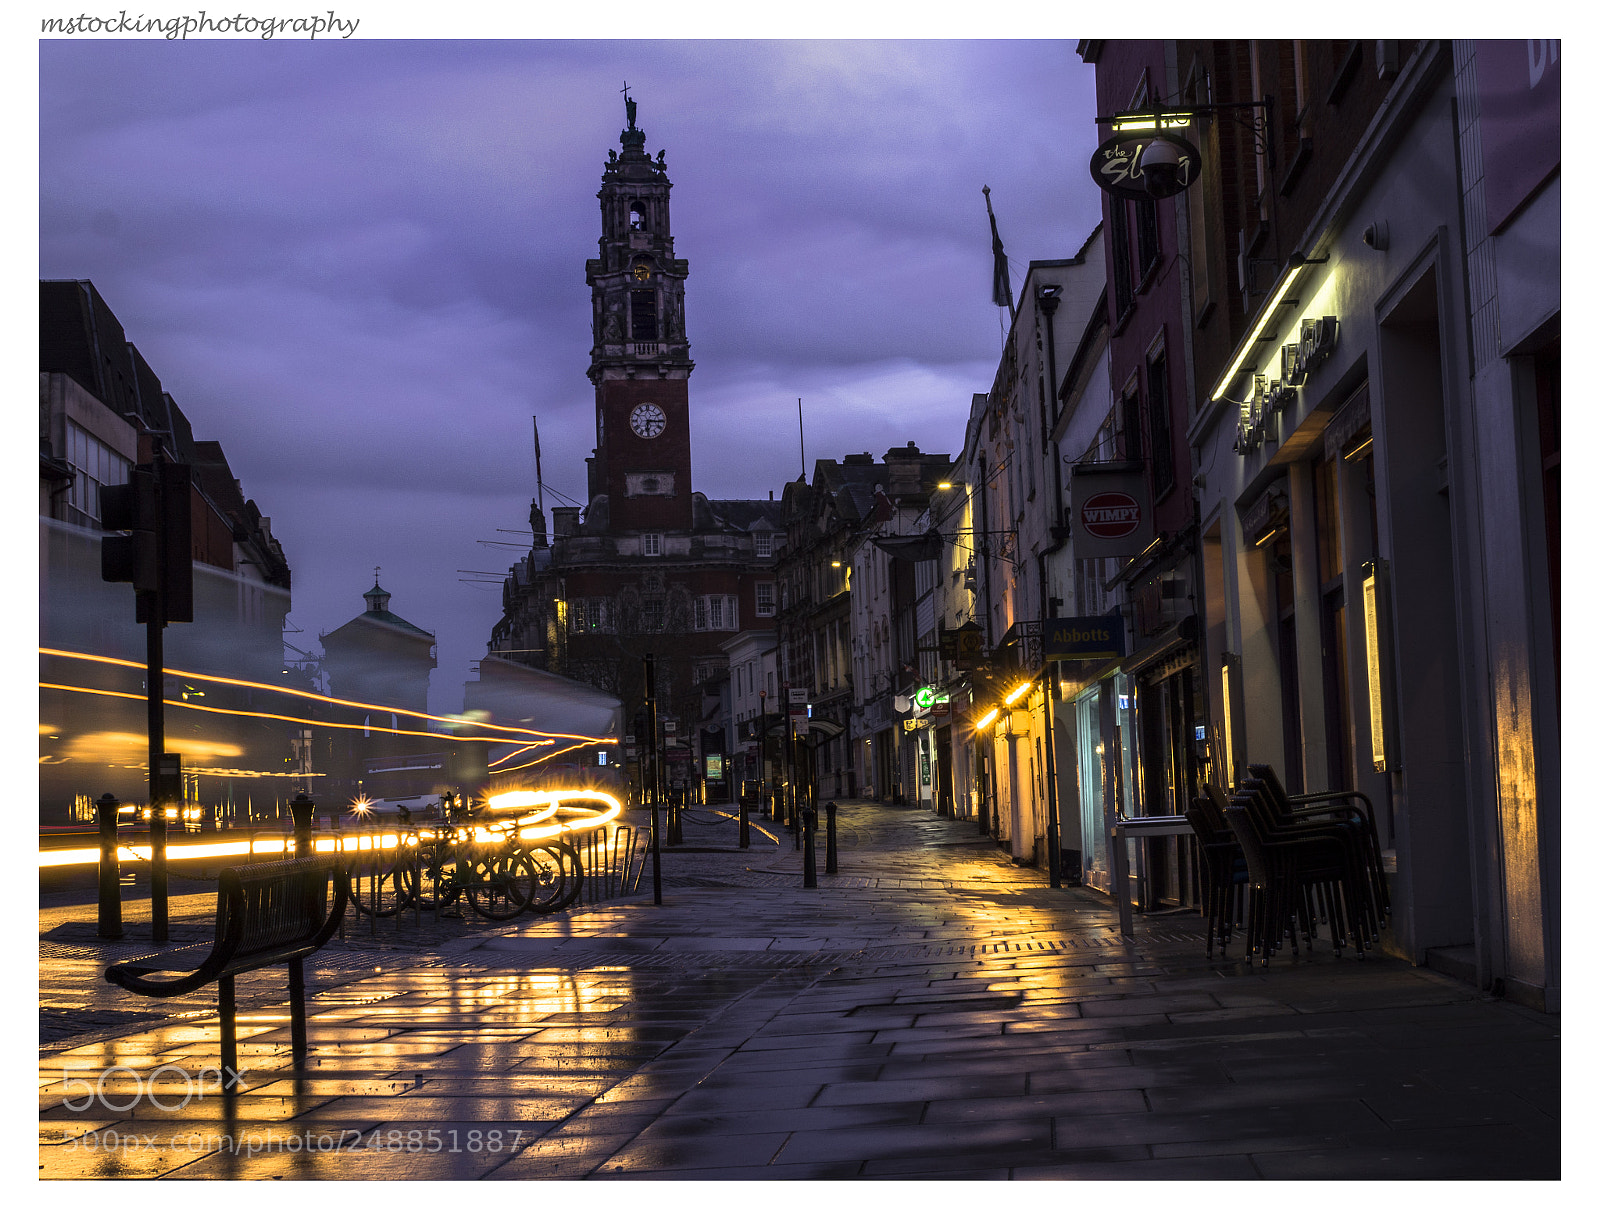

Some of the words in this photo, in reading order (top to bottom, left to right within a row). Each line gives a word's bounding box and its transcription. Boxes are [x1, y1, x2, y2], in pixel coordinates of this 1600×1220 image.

[1102, 144, 1133, 159] the
[1083, 507, 1139, 523] WIMPY
[1052, 627, 1110, 643] Abbotts
